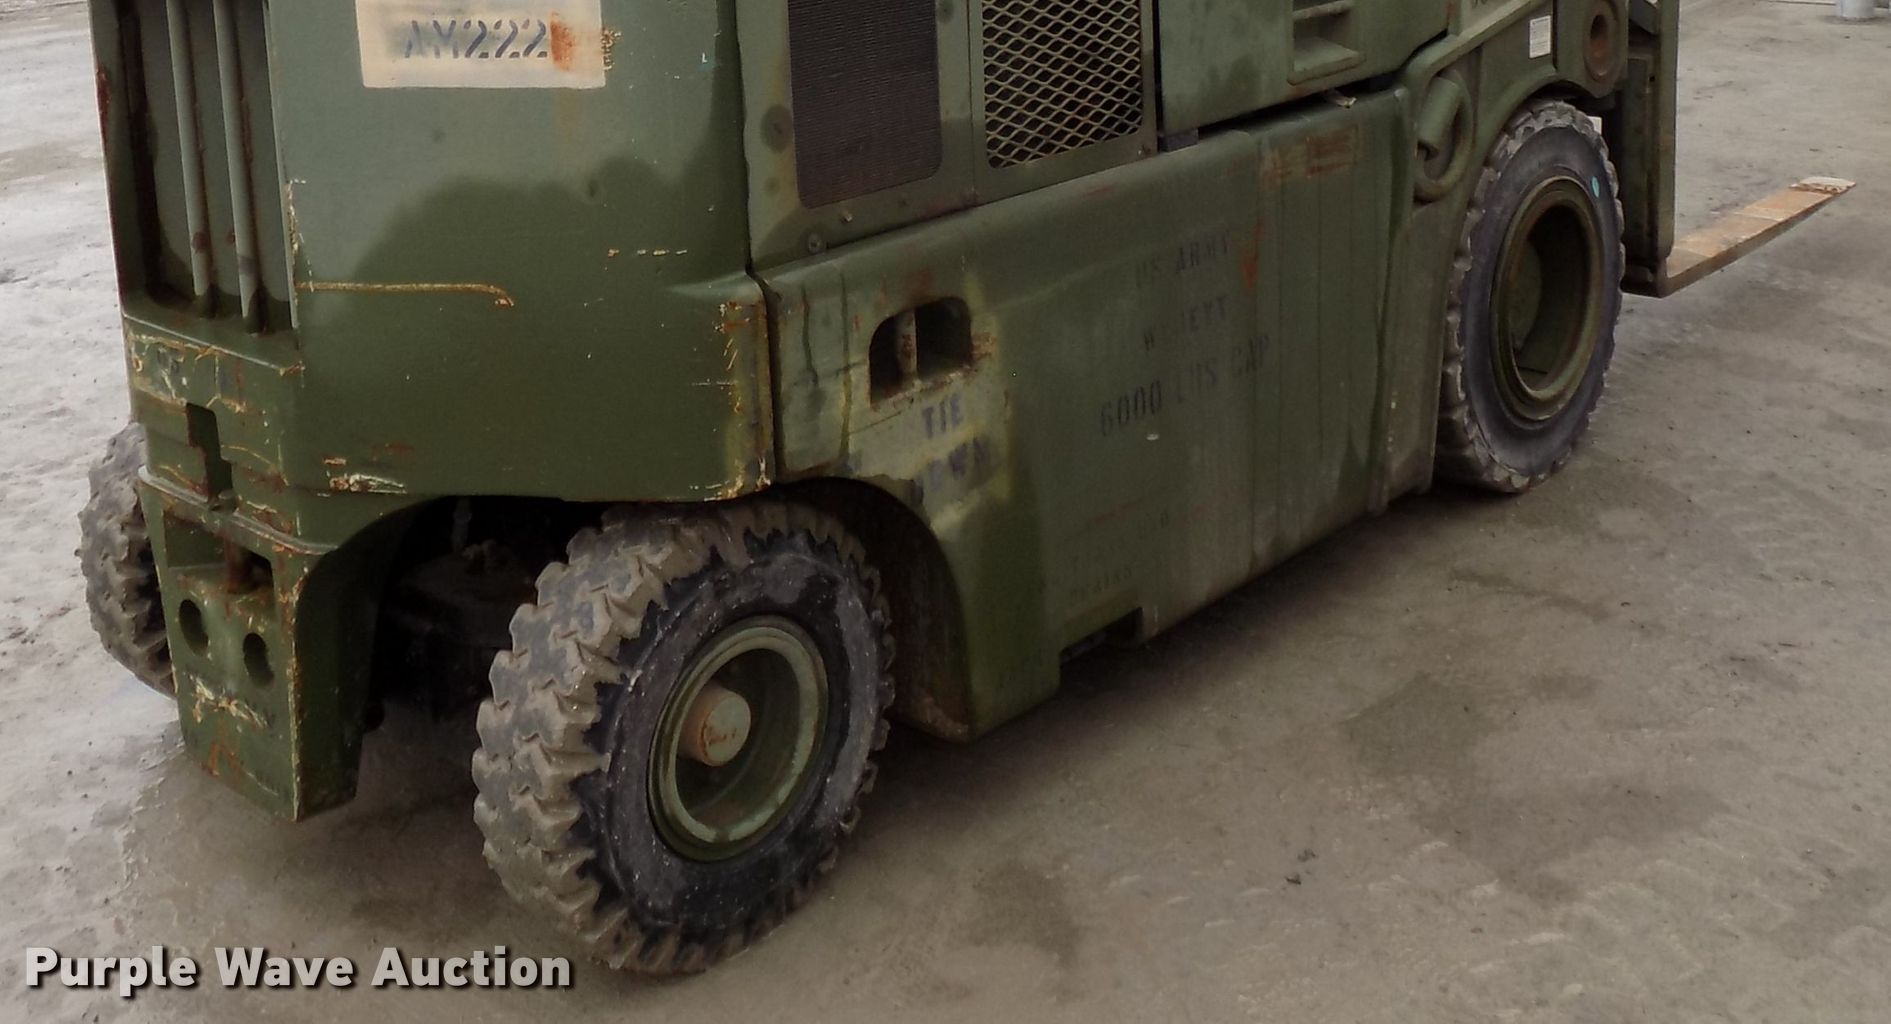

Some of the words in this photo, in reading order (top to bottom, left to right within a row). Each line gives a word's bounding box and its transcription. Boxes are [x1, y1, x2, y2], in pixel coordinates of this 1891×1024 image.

[403, 18, 549, 60] AM222
[921, 393, 965, 441] TIE
[1100, 378, 1163, 438] 6000
